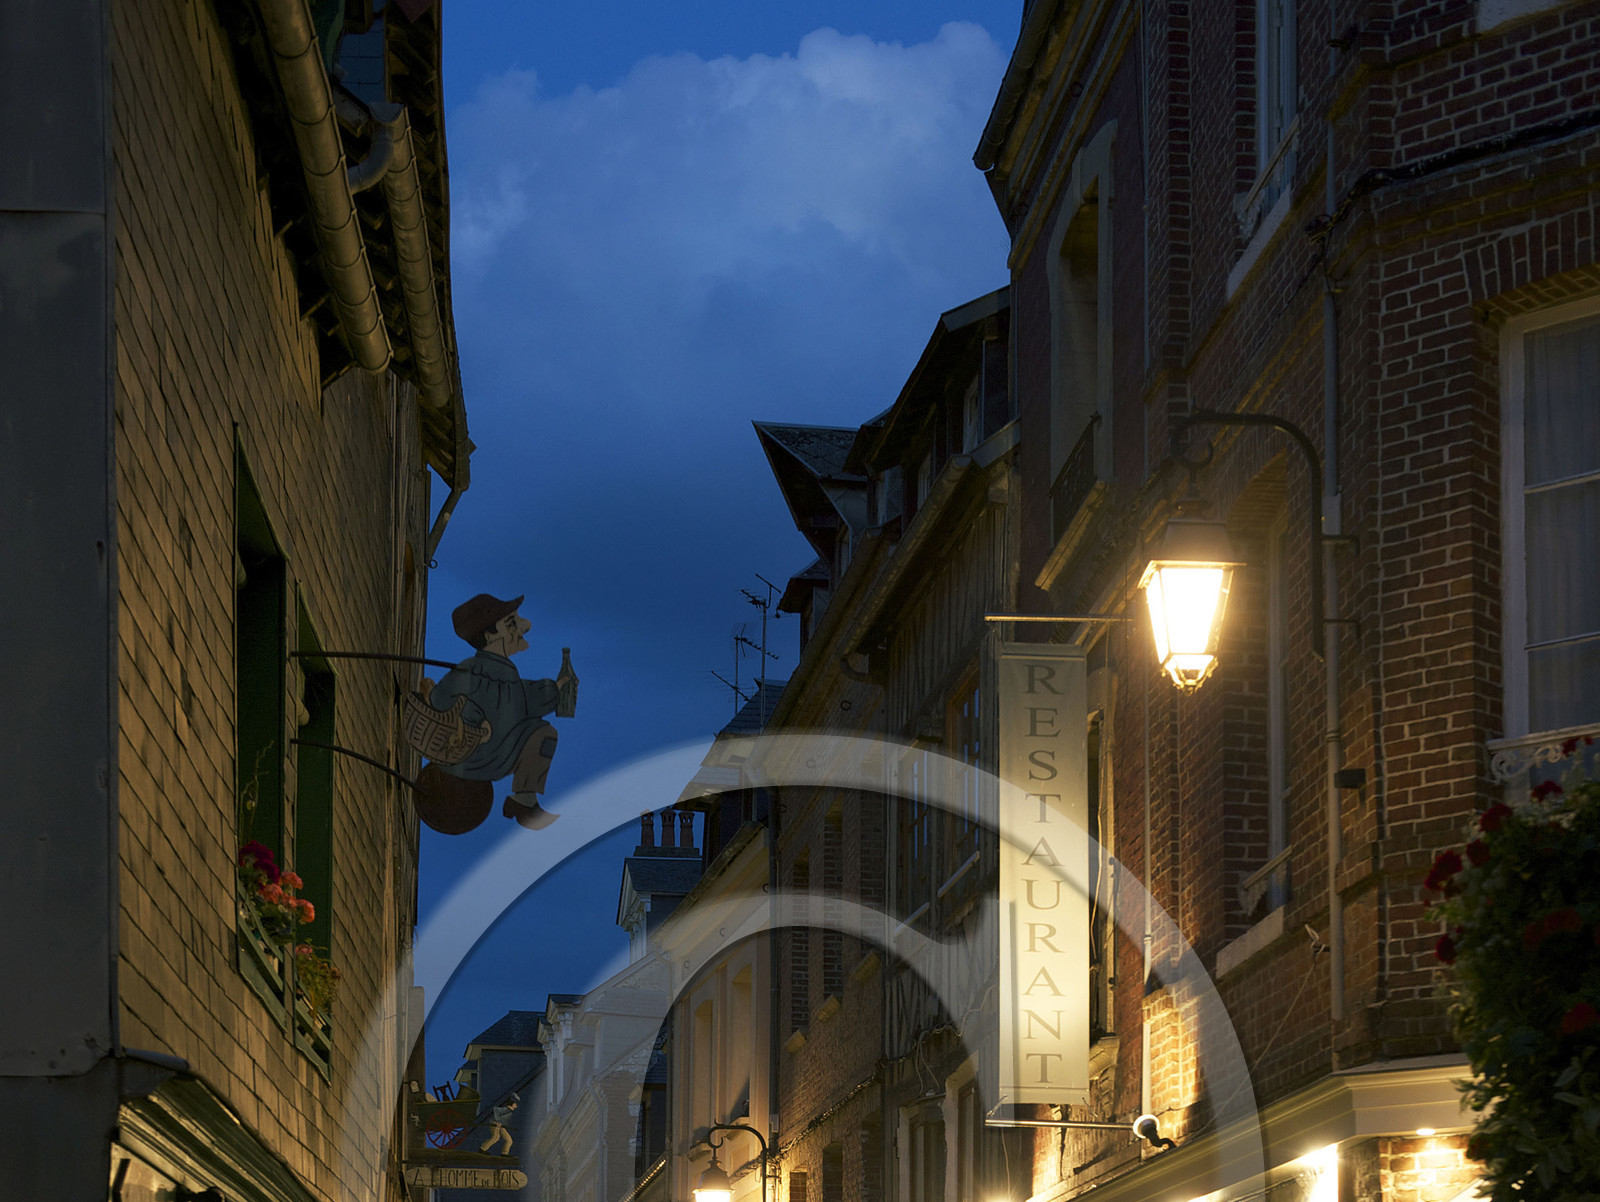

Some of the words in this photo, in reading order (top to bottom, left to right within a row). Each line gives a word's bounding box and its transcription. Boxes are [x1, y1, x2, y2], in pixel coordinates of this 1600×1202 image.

[1022, 663, 1067, 1084] RESTAURANT
[413, 1168, 424, 1186] A
[431, 1168, 479, 1187] L'HOMME
